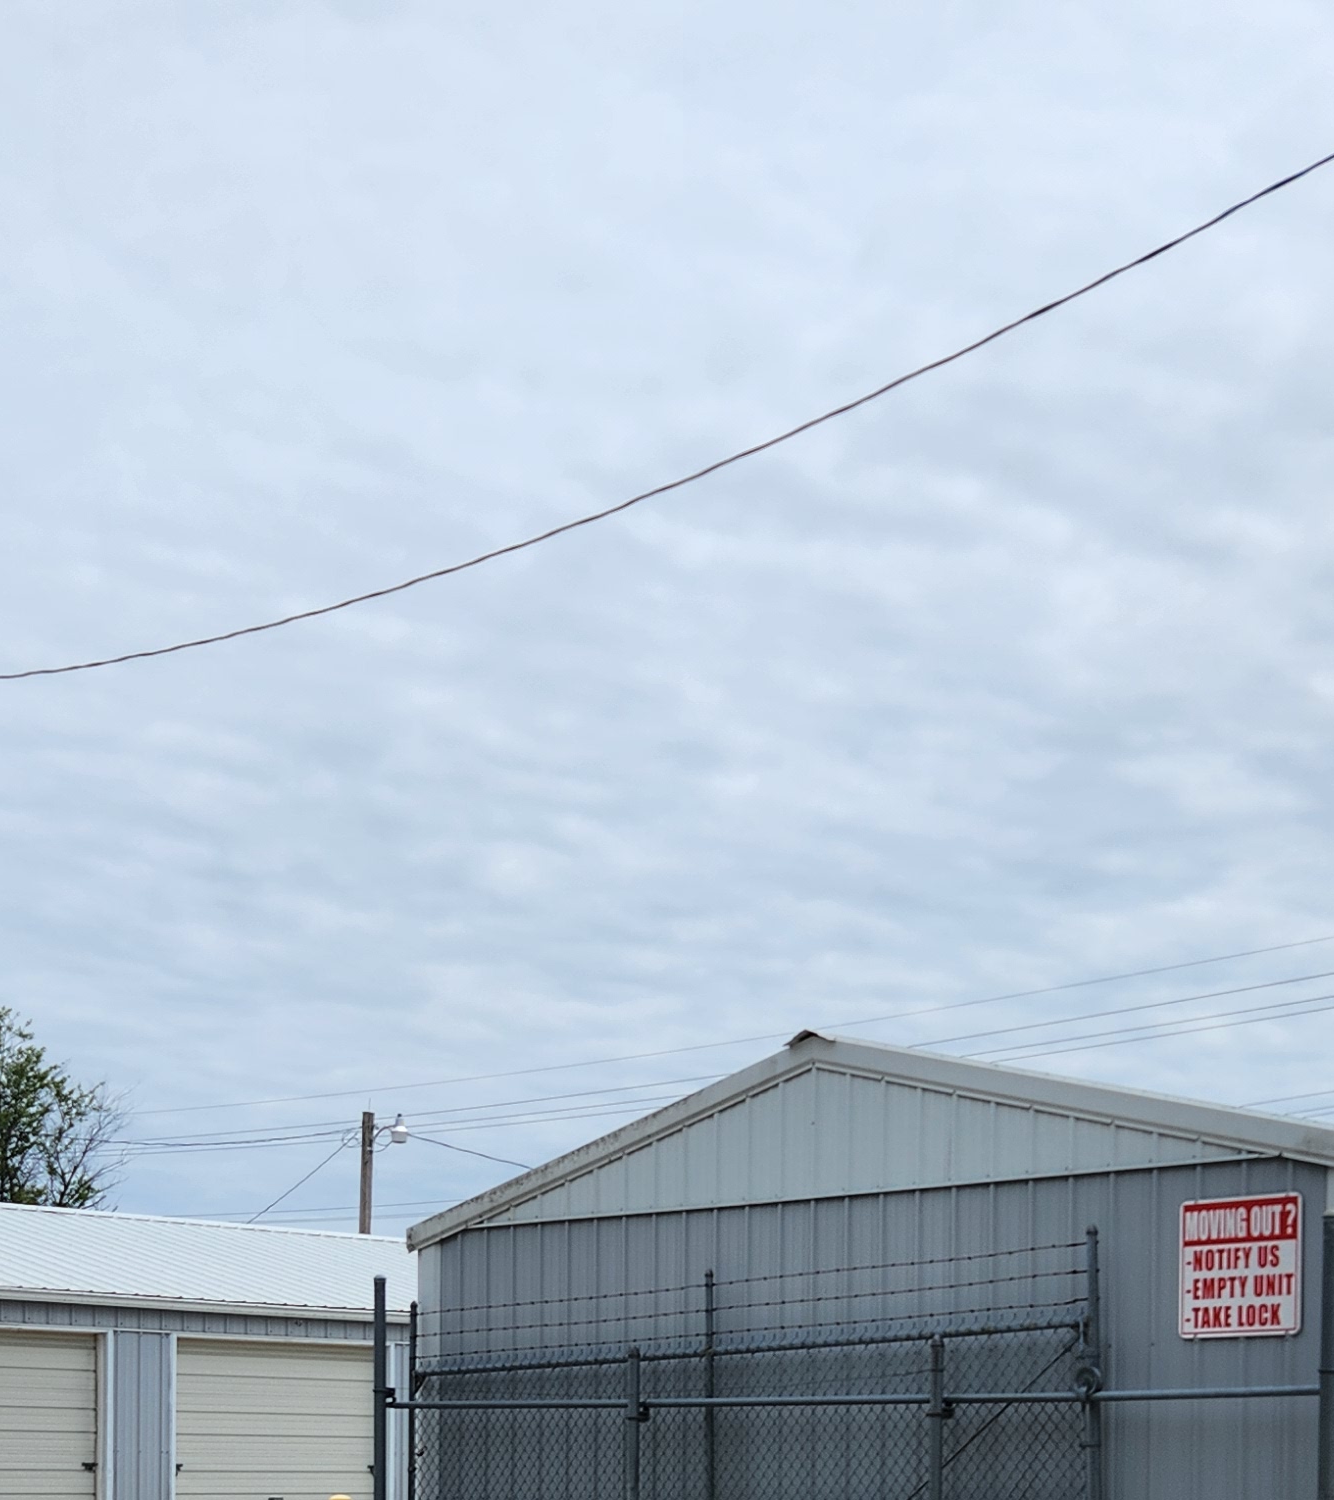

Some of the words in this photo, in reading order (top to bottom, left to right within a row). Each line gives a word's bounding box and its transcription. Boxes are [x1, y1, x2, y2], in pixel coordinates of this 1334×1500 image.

[1184, 1206, 1248, 1242] MOVING
[1257, 1244, 1280, 1268] US
[1253, 1273, 1295, 1297] UNIT
[1237, 1303, 1282, 1327] LOCK
